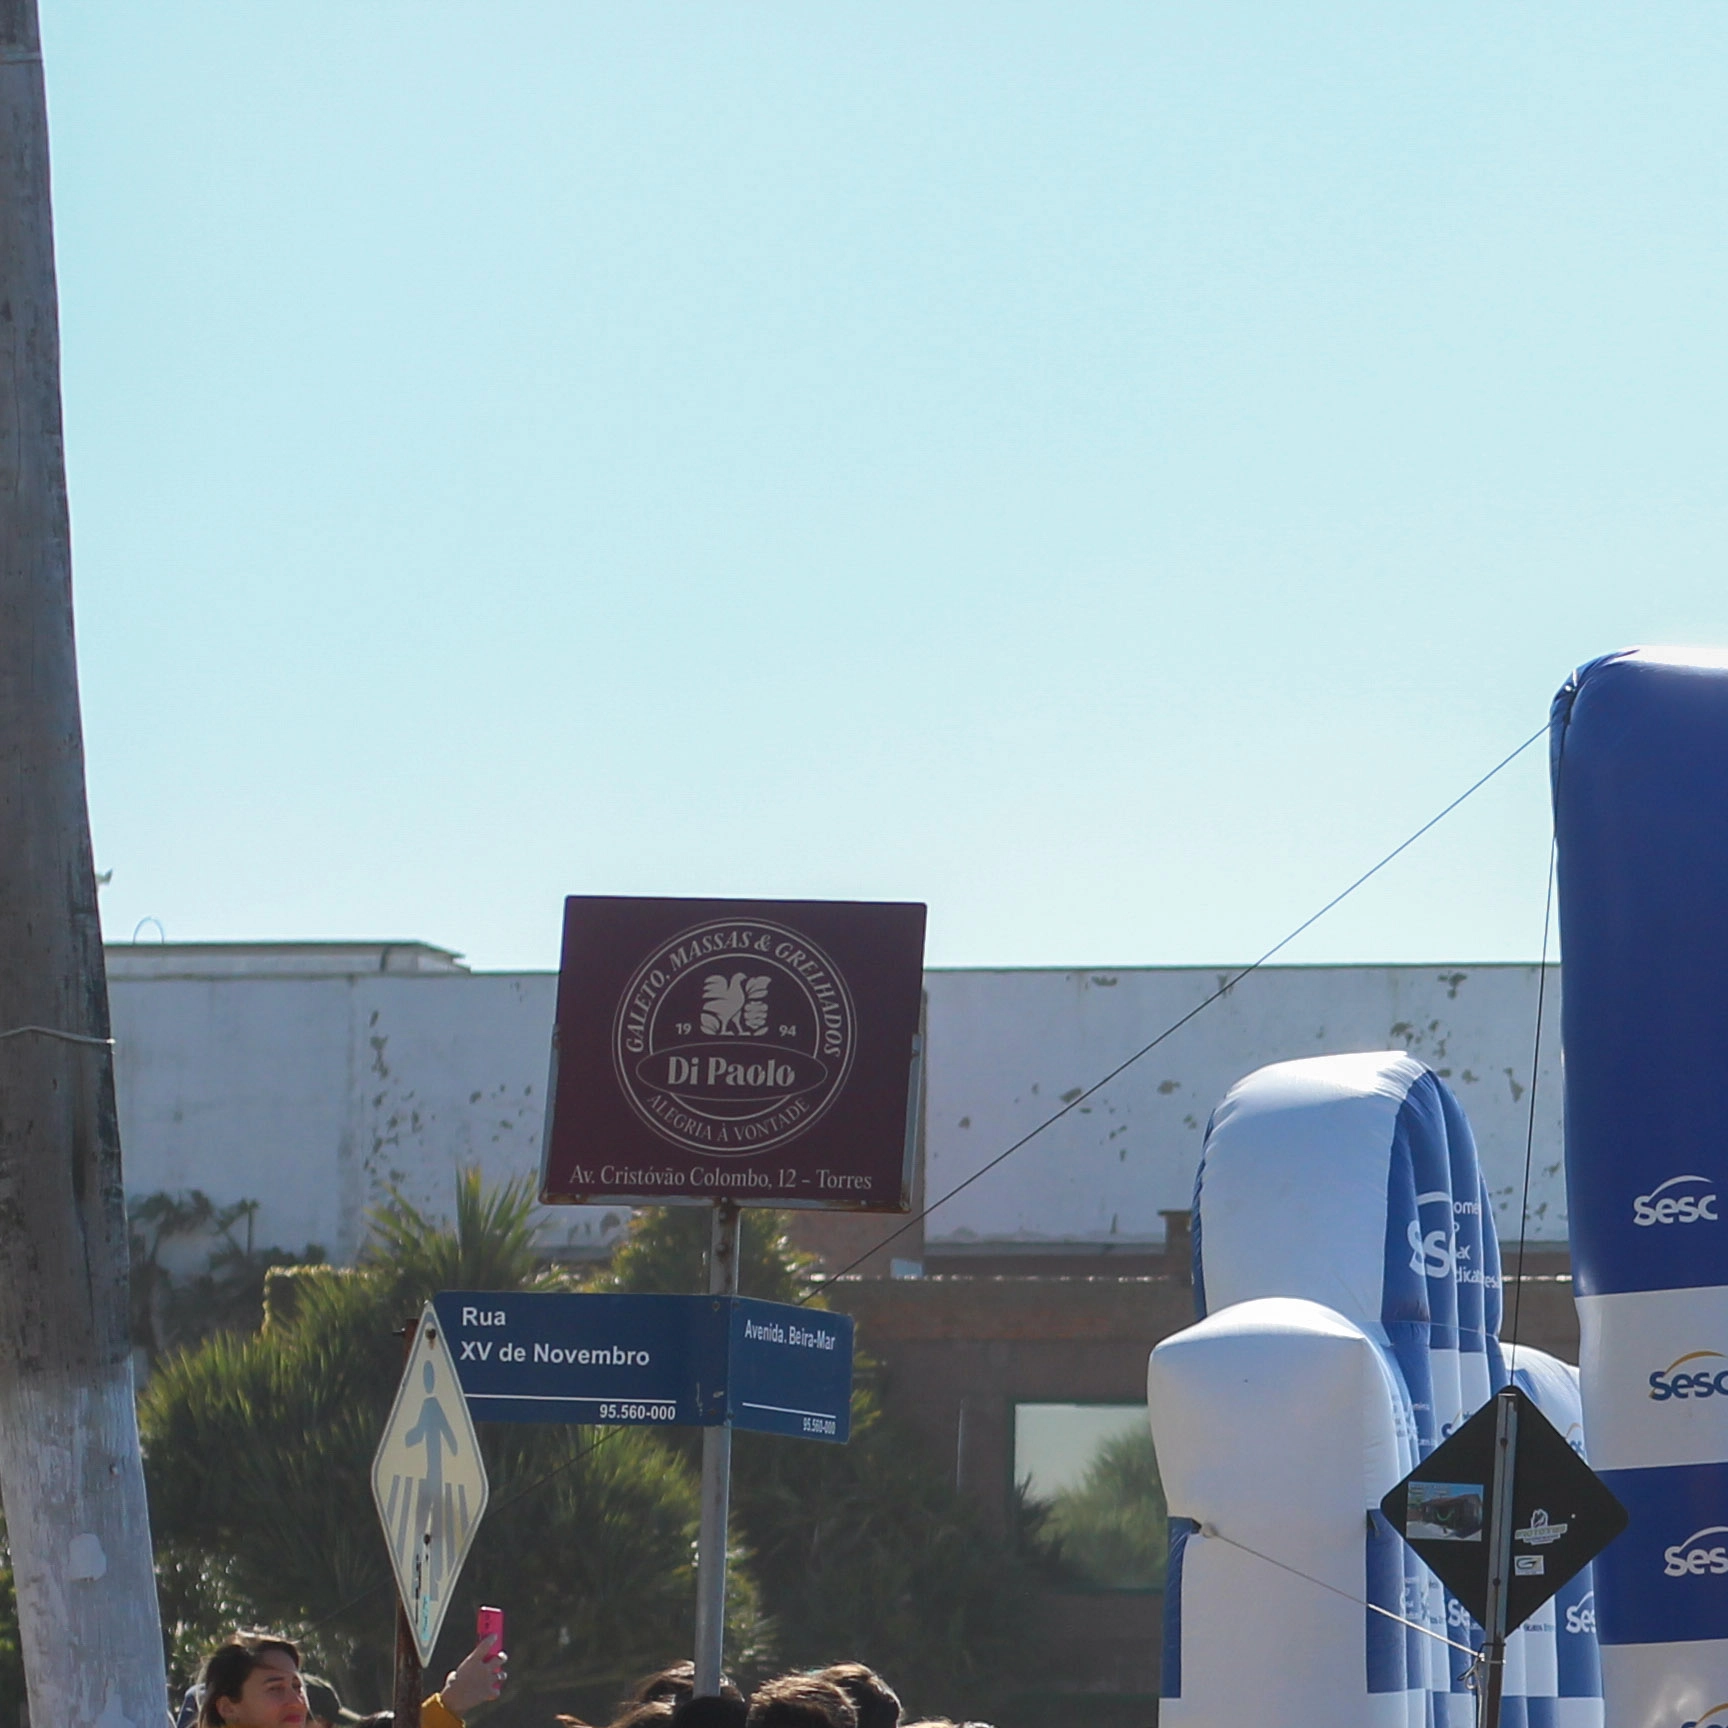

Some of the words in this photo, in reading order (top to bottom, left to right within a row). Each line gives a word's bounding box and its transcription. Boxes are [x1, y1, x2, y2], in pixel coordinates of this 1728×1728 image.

[626, 966, 672, 1054] GALETO,
[669, 930, 752, 972] MASSAS
[753, 935, 772, 952] &
[774, 942, 841, 1058] GRELHADOS
[675, 1023, 692, 1036] 19
[779, 1024, 797, 1038] 94
[667, 1055, 699, 1087] Di
[707, 1056, 796, 1088] Paolo
[646, 1094, 713, 1141] ALEGRIA
[715, 1121, 730, 1143] À
[733, 1099, 811, 1142] VONTADE
[570, 1165, 596, 1185] Av.
[600, 1164, 686, 1187] Cristóvão
[689, 1166, 773, 1189] Colombo,
[776, 1168, 797, 1188] 12
[815, 1169, 872, 1190] Torres
[1633, 1193, 1719, 1226] Sesc
[461, 1306, 507, 1328] Rua
[788, 1325, 836, 1352] Beira-Mar
[459, 1340, 493, 1362] XV
[499, 1342, 527, 1364] de
[532, 1344, 651, 1367] Novembro
[599, 1403, 677, 1421] 95.560-000
[802, 1416, 837, 1436] 95.560-000
